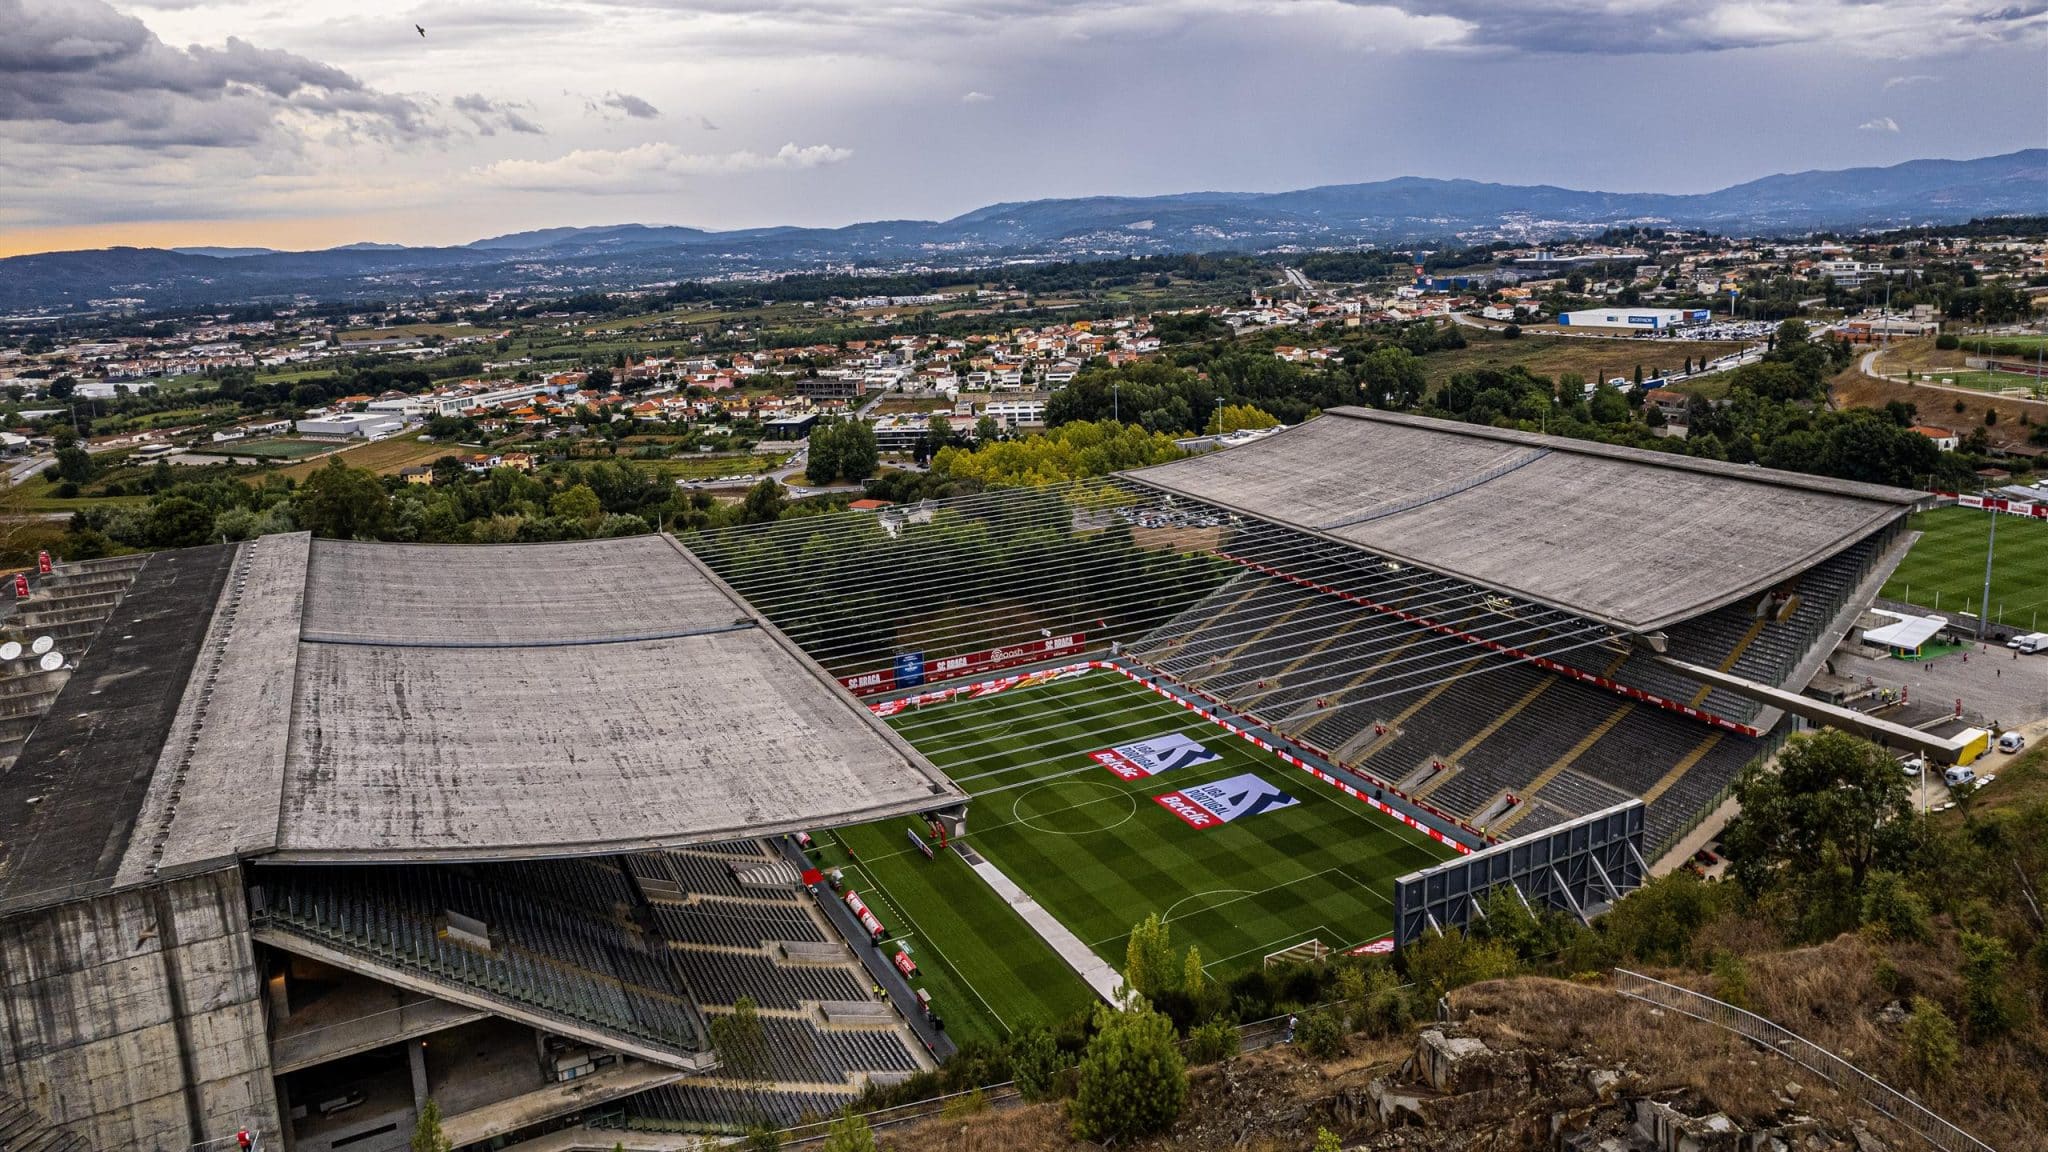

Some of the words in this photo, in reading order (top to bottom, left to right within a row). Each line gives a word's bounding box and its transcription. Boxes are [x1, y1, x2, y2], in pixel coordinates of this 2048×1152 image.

[1045, 640, 1054, 651] SC
[1054, 636, 1073, 649] BRAGA
[936, 661, 946, 672] SC
[946, 657, 968, 669] BRAGA
[848, 678, 858, 689] SC
[858, 673, 881, 687] BRAGA
[1094, 753, 1138, 778] Betclic
[1202, 785, 1227, 798] LIGA
[1185, 789, 1231, 815] PORTUGAL
[1160, 796, 1210, 825] Betclic
